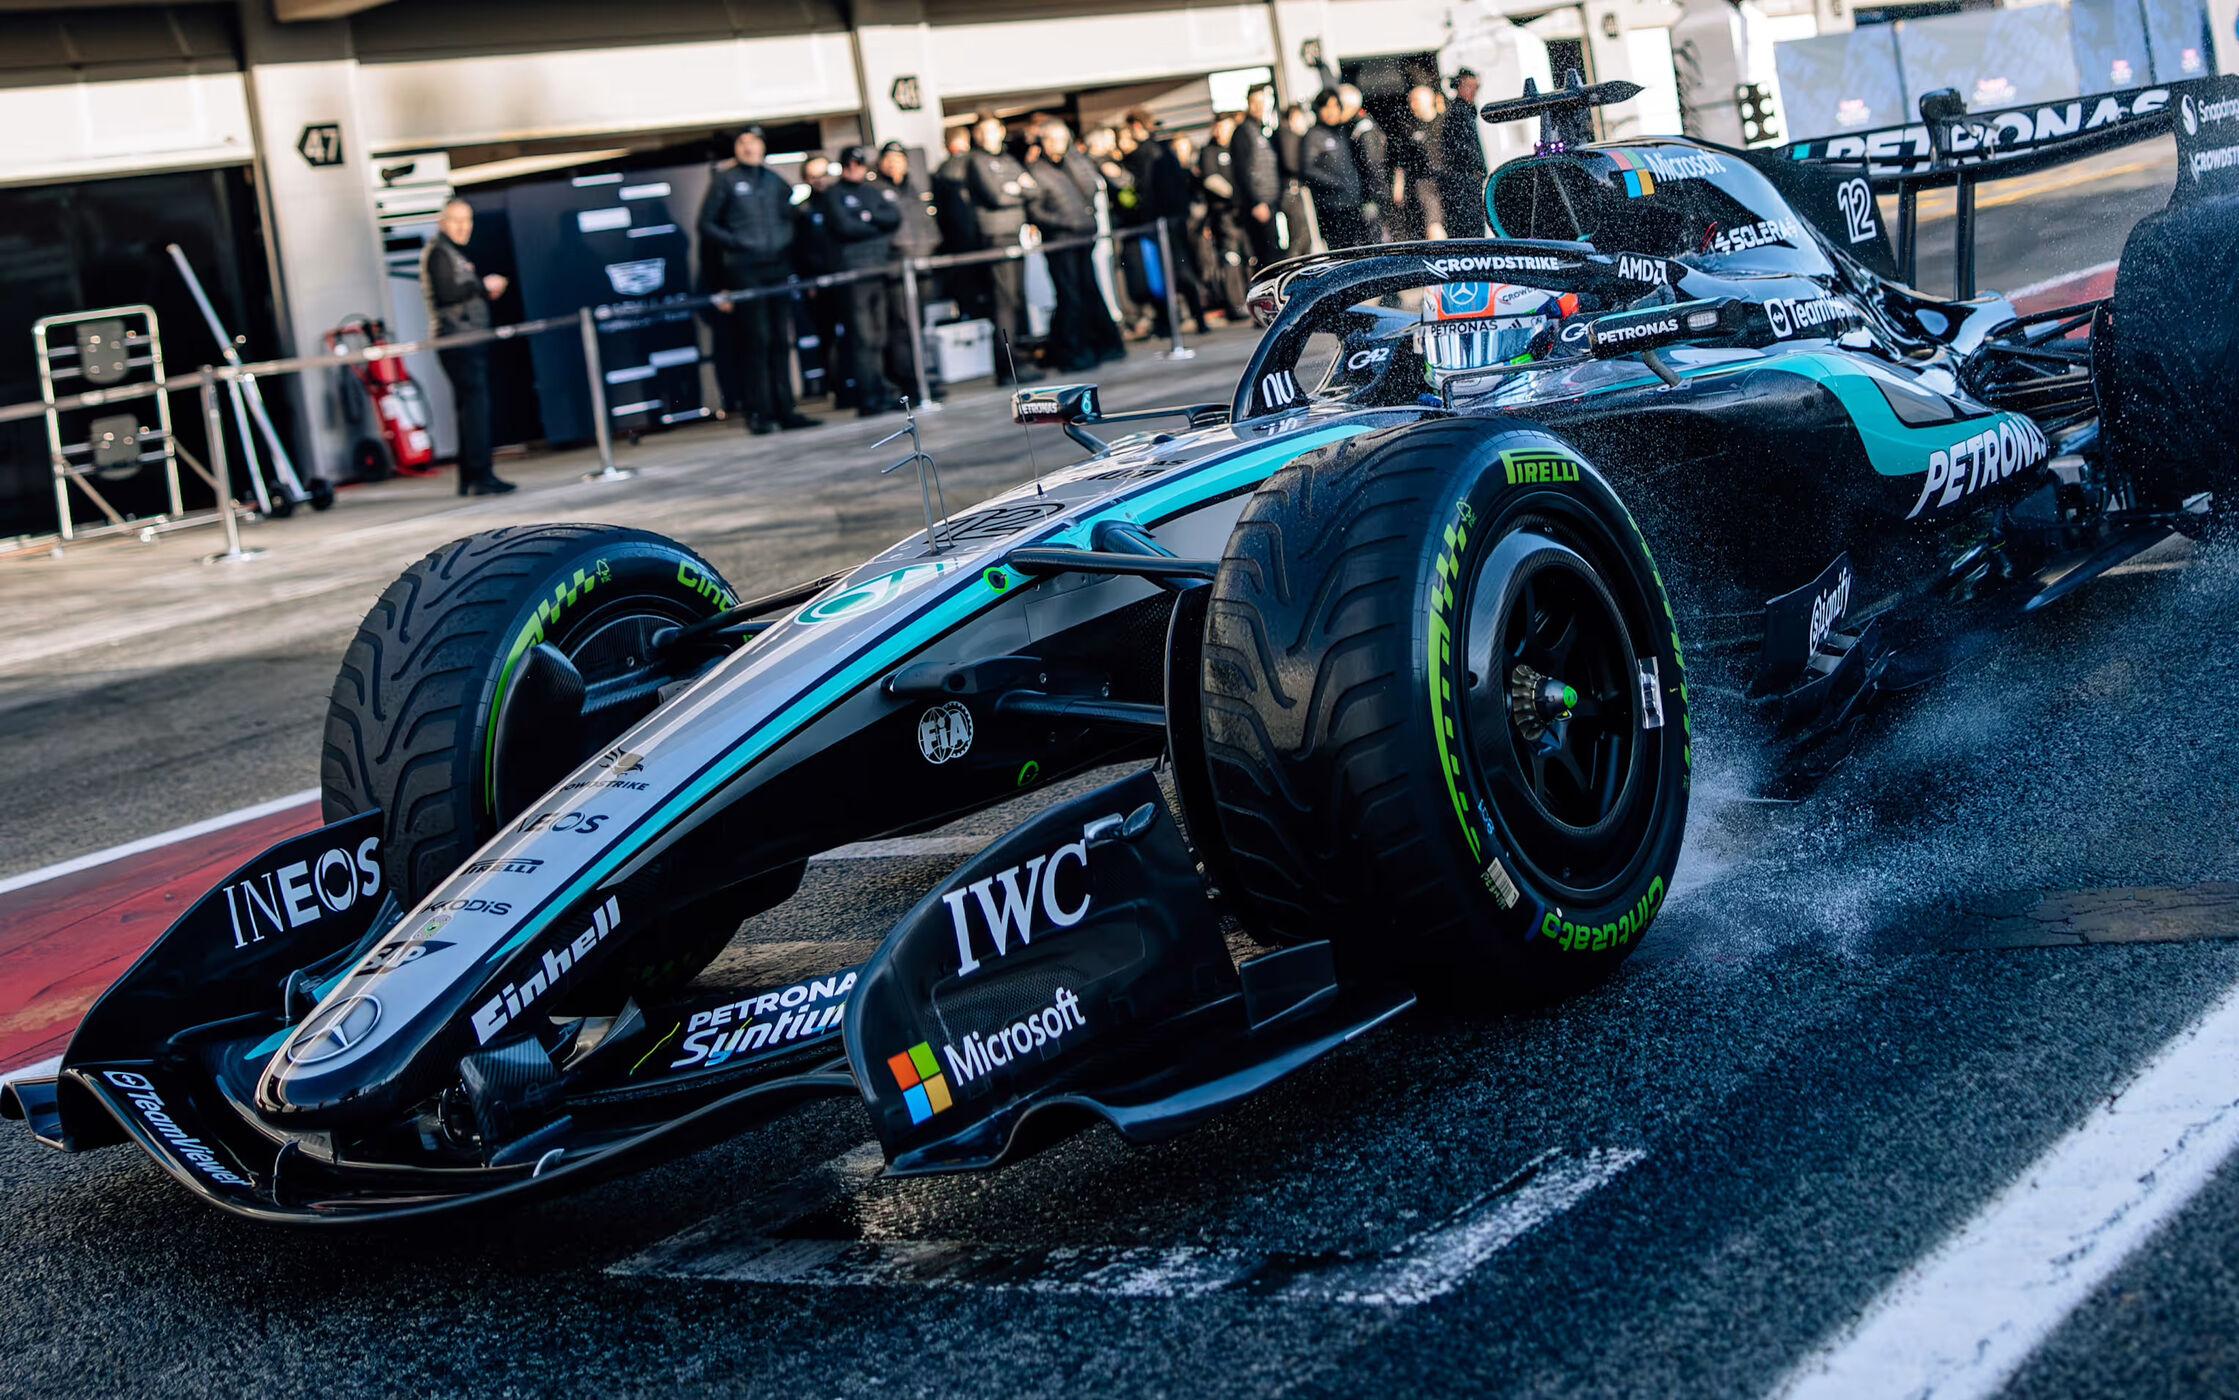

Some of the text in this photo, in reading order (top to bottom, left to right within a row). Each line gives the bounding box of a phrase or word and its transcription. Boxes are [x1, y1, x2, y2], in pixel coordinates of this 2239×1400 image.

[303, 127, 340, 163] 47
[1645, 150, 1726, 183] Microsoft
[1837, 178, 1878, 244] 12
[1435, 256, 1560, 273] CROWDSTRIKE
[1348, 347, 1390, 371] G42
[1431, 320, 1498, 336] PETRONAS
[1598, 318, 1679, 345] PETRONAS
[1498, 447, 1580, 485] PIRELLI
[1904, 413, 2049, 521] PETRONAS
[223, 836, 381, 949] INEOS
[942, 838, 1091, 978] IWC
[1541, 875, 1665, 952] Cinturato
[471, 894, 621, 1046] Einhell
[687, 971, 859, 1033] PETRONA
[670, 1002, 847, 1069] Syntiu
[943, 986, 1087, 1087] Microsoft
[126, 1091, 256, 1187] TeamViewer
